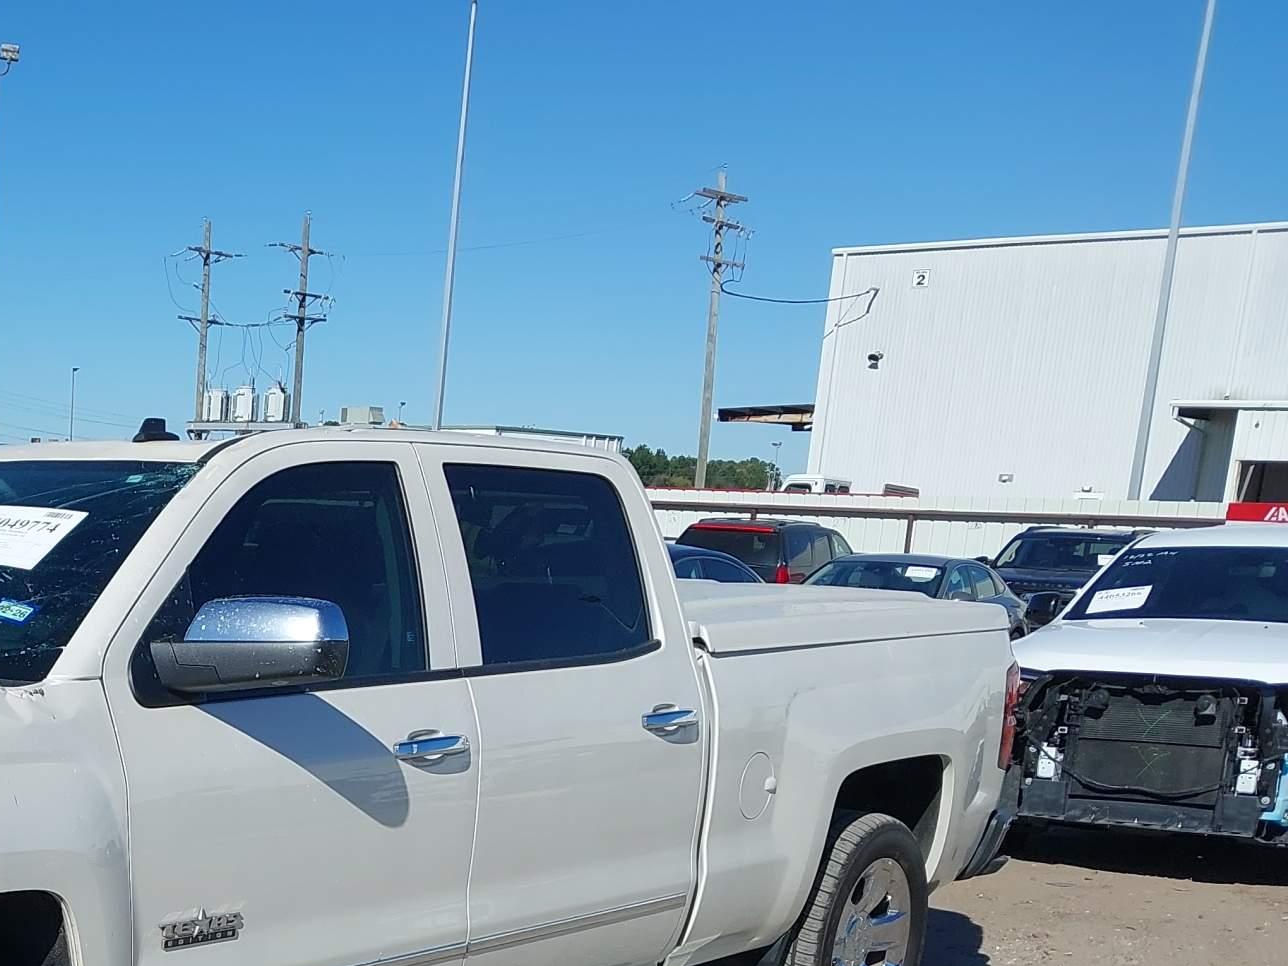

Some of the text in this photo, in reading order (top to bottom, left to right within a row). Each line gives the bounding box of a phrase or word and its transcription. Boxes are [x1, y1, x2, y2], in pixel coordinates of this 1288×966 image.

[915, 274, 926, 286] 2
[158, 904, 244, 939] TEXAS
[167, 929, 235, 948] EDITION
